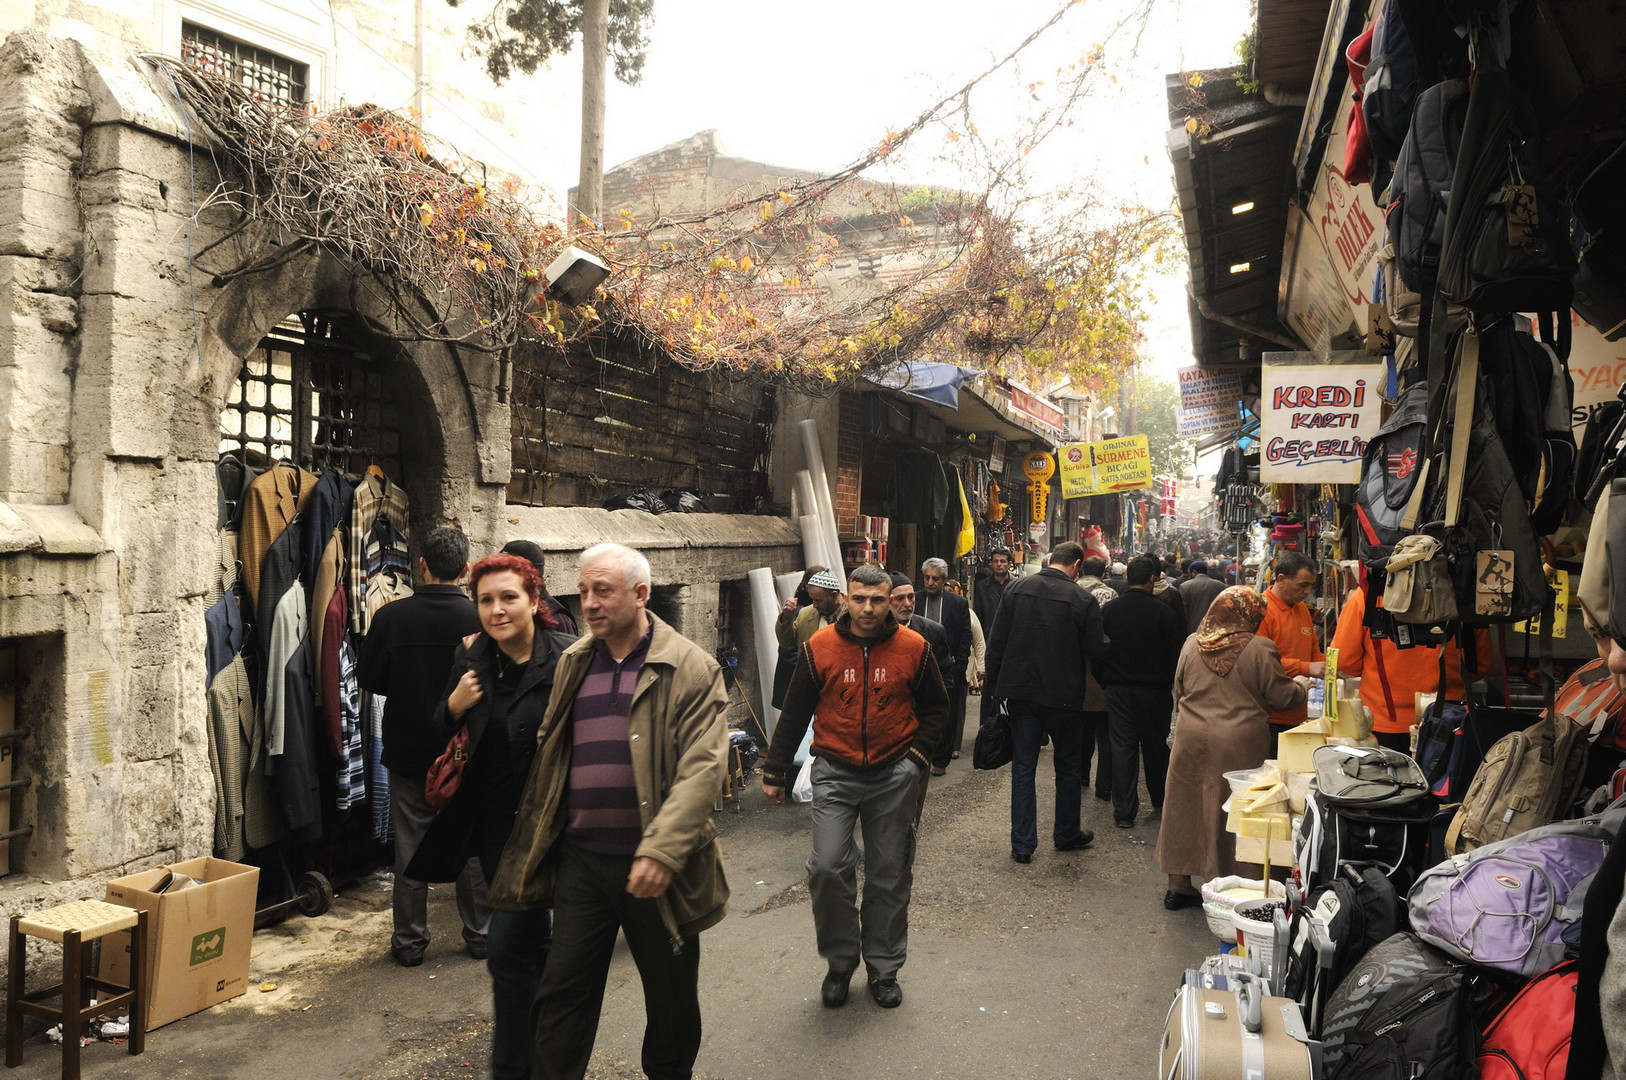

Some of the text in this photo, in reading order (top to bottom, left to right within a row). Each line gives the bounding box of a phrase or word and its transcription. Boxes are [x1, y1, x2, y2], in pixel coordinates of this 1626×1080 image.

[1179, 369, 1204, 382] KAYA
[1273, 379, 1366, 410] KREDİ
[1291, 412, 1359, 429] KARTI
[1096, 447, 1147, 465] SÜRMENE
